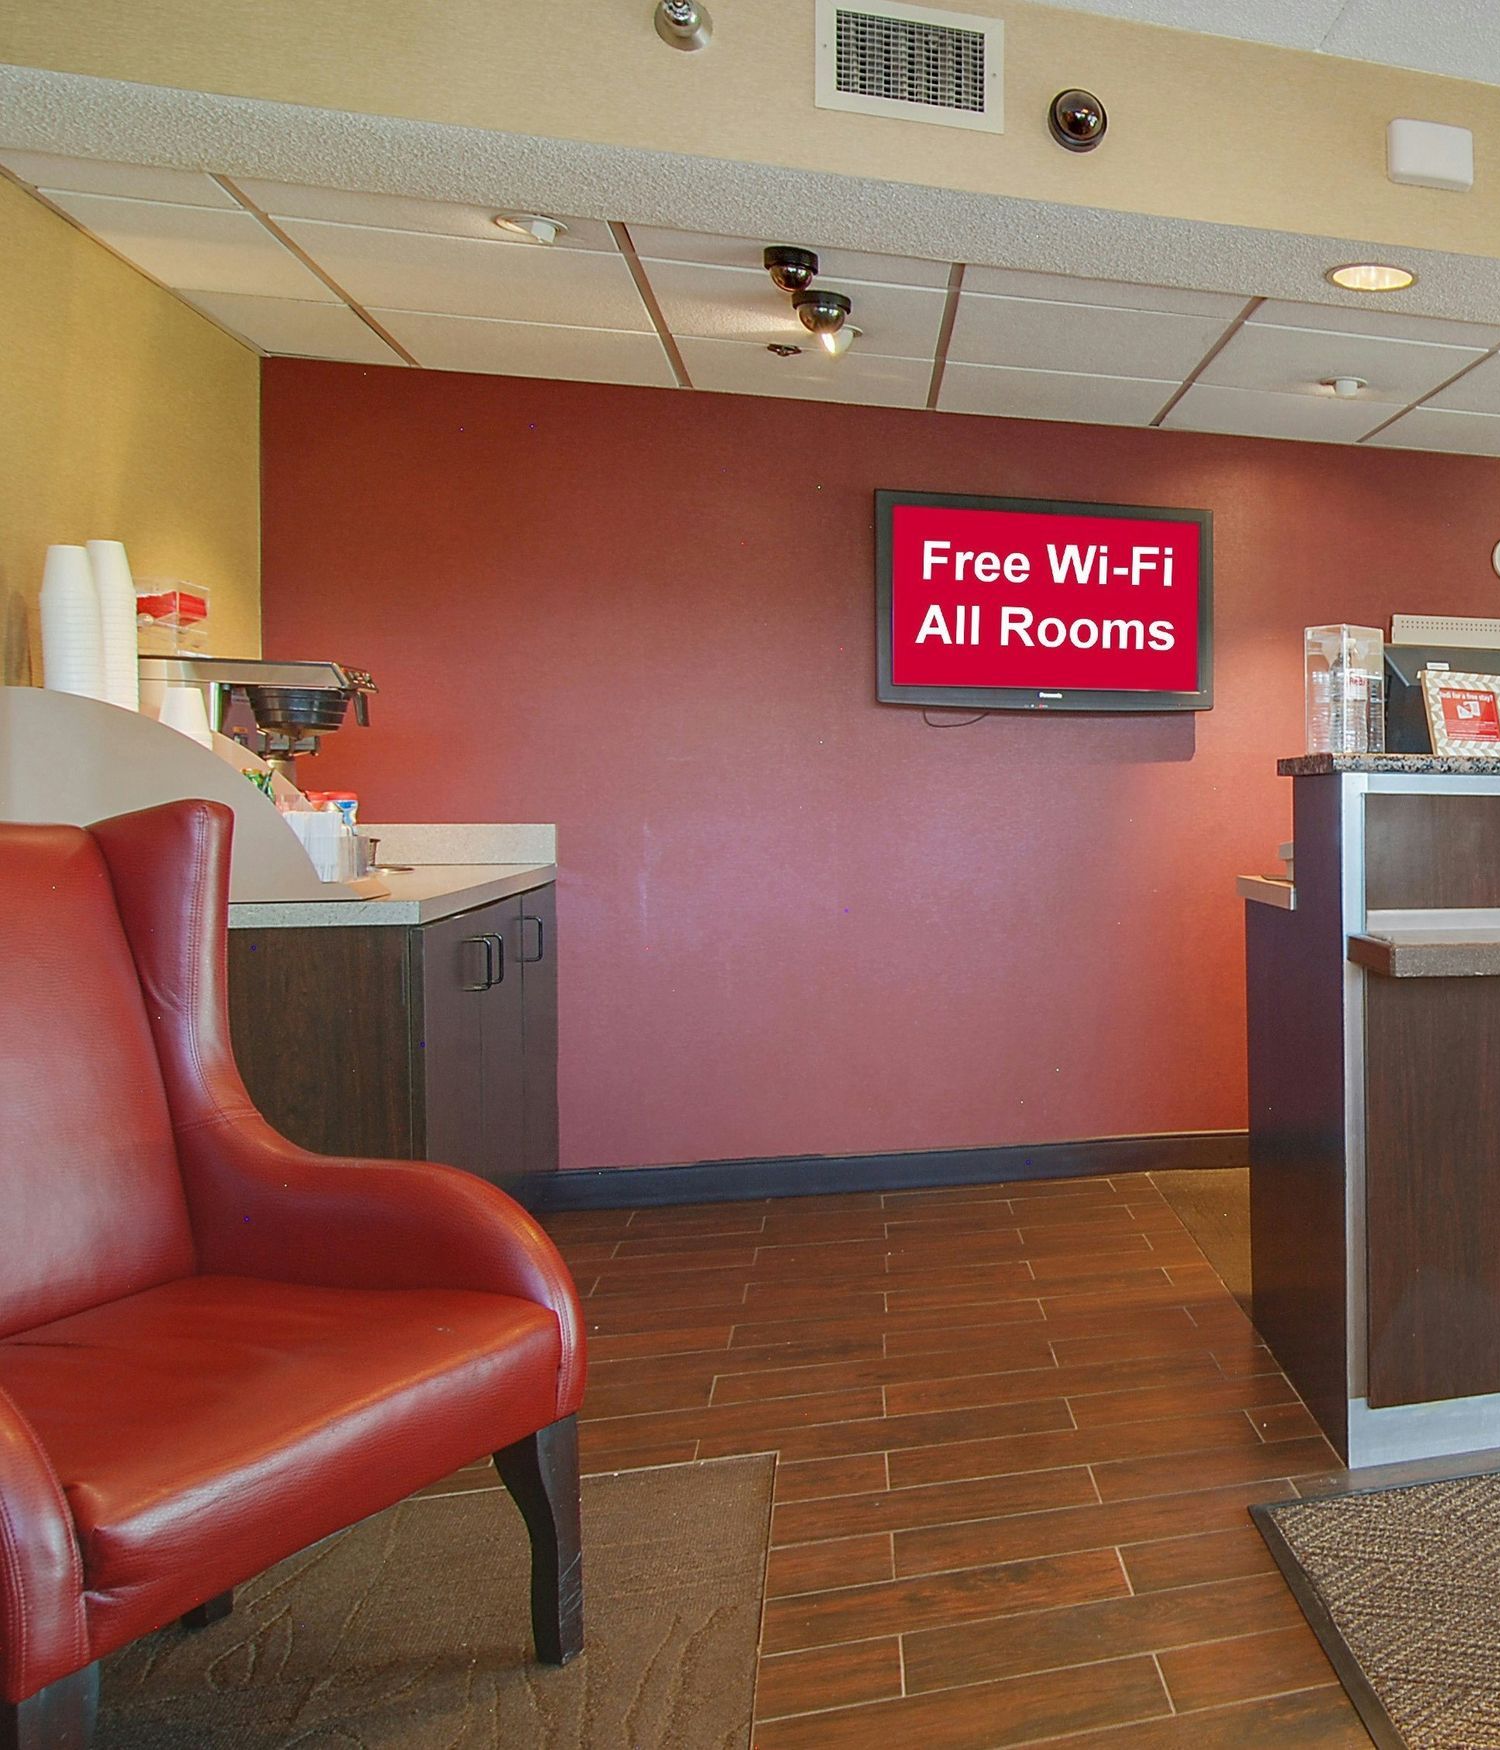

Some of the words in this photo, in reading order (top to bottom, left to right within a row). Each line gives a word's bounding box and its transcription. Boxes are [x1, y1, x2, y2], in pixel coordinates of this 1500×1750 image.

[922, 540, 1031, 584] Free
[1046, 543, 1174, 587] Wi-Fi
[915, 604, 981, 646] All
[1000, 606, 1175, 651] Rooms
